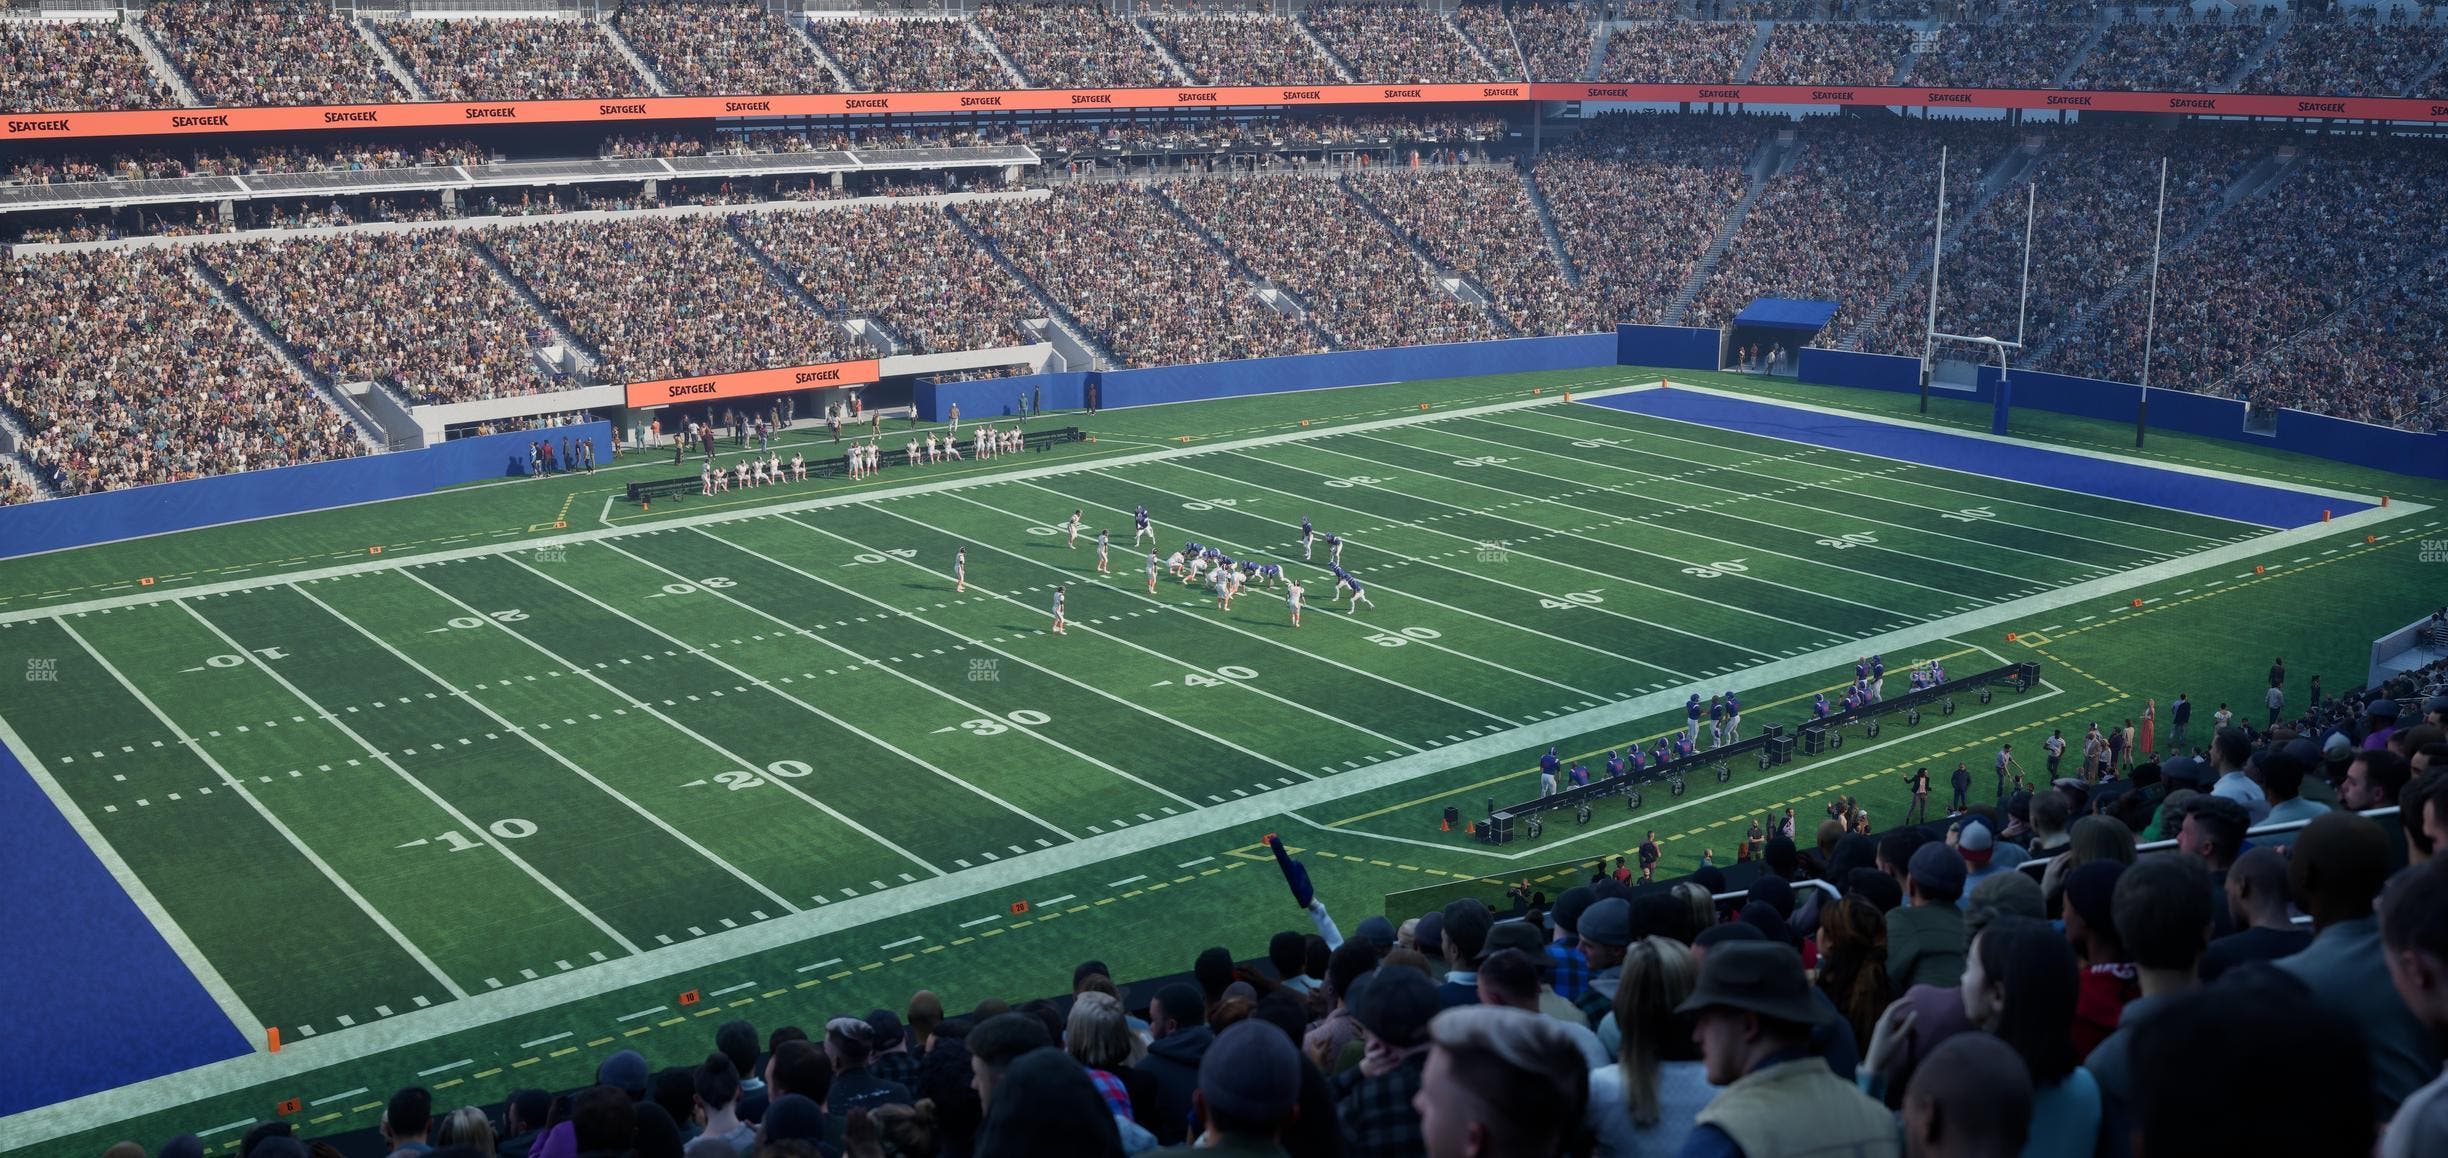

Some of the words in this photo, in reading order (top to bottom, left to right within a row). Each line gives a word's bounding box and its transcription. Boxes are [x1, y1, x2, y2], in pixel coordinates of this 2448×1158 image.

[1179, 93, 1216, 101] SEATGEEK
[1284, 91, 1320, 99] SEATGEEK
[1385, 90, 1421, 98] SEATGEEK
[1588, 88, 1628, 97] SEATGEEK
[1699, 90, 1740, 98] SEATGEEK
[1812, 91, 1853, 100] SEATGEEK
[1929, 94, 1971, 102] SEATGEEK
[846, 99, 888, 109] SEATGEEK
[961, 97, 1001, 106] SEATGEEK
[1072, 95, 1111, 104] SEATGEEK
[2047, 96, 2092, 105] SEATGEEK
[2170, 99, 2216, 108] SEATGEEK
[600, 104, 646, 115] SEATGEEK
[726, 101, 770, 112] SEATGEEK
[2297, 102, 2345, 112] SEATGEEK
[325, 111, 377, 123] SEATGEEK
[466, 107, 515, 118] SEATGEEK
[9, 120, 70, 132] SEATGEEK
[172, 115, 228, 127] SEATGEEK
[796, 369, 839, 384] SEATGEEK
[669, 382, 716, 397] SEATGEEK
[1815, 534, 1879, 549] 20
[1681, 562, 1748, 578] 30
[1539, 592, 1603, 609] 40
[1362, 627, 1441, 647] 50
[1185, 666, 1259, 687] 40
[960, 710, 1051, 735] 30
[713, 760, 813, 791] 20
[435, 818, 538, 852] 10
